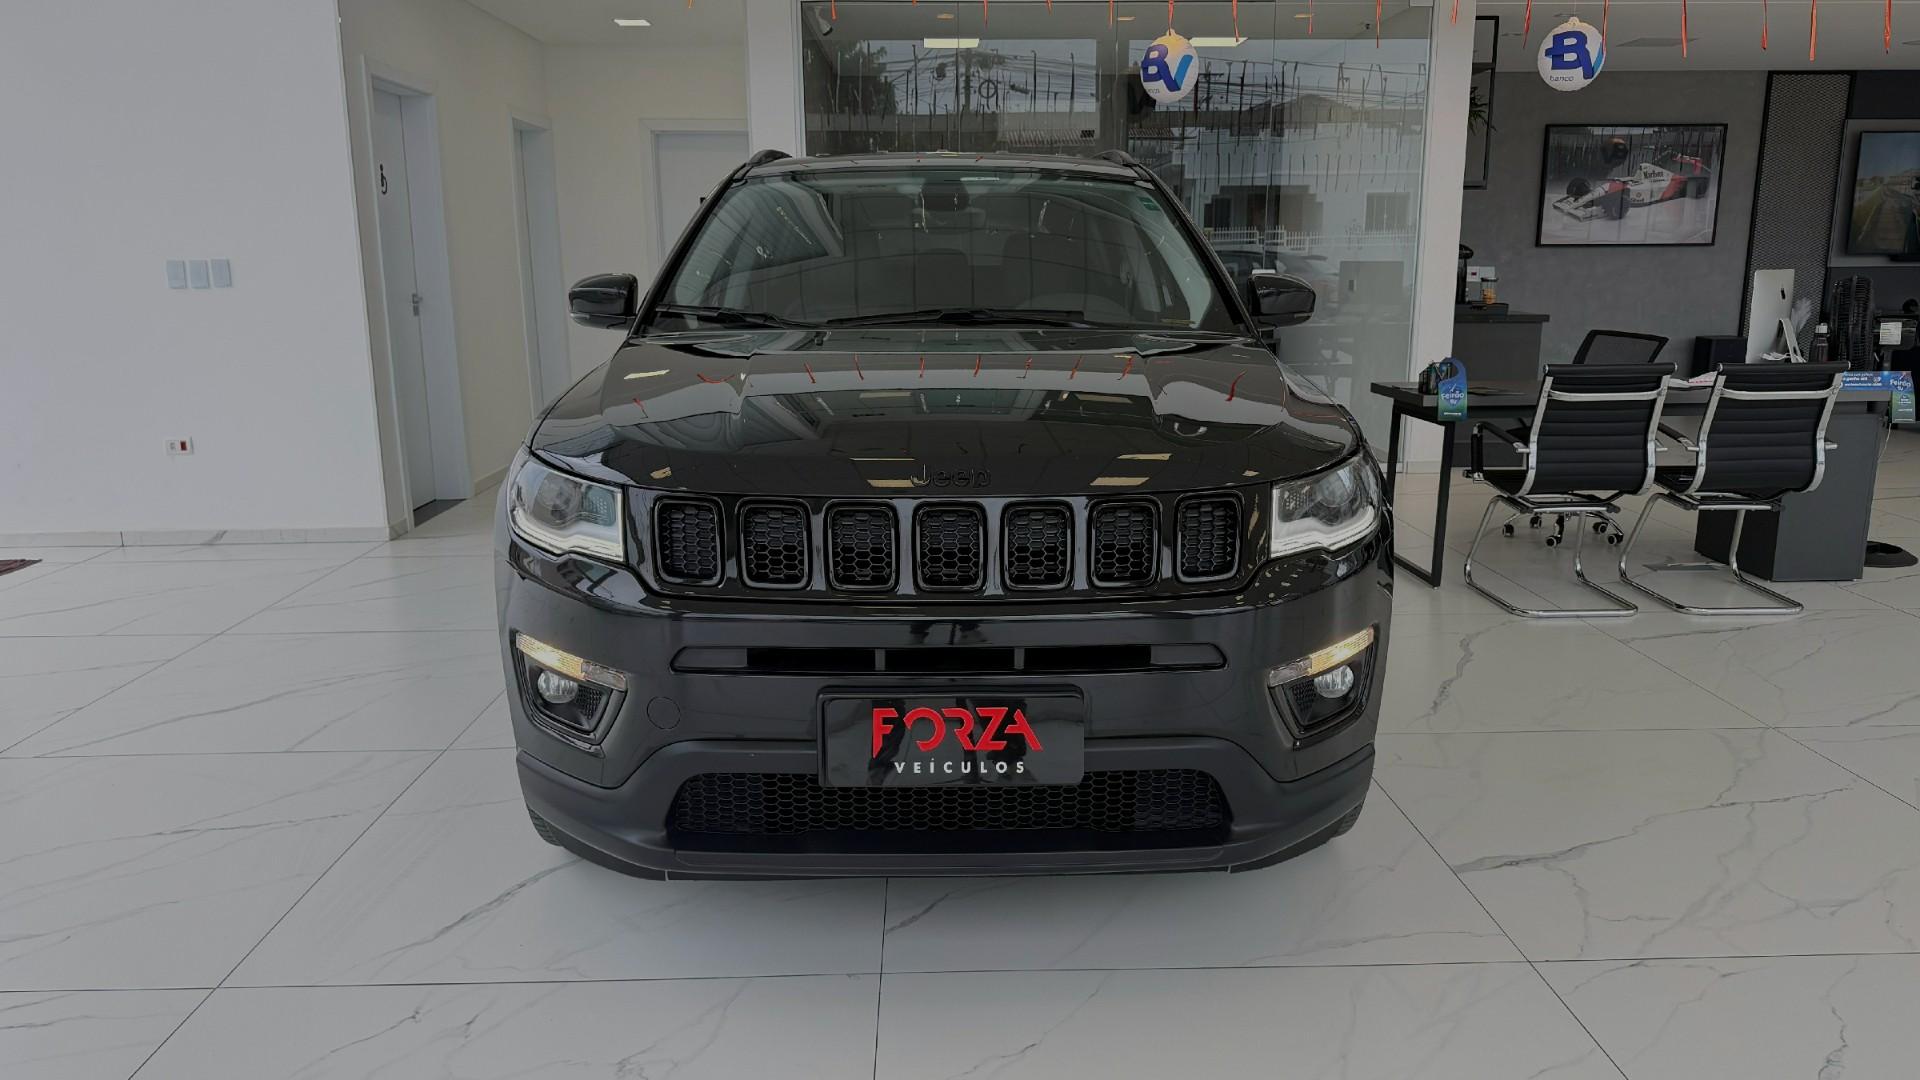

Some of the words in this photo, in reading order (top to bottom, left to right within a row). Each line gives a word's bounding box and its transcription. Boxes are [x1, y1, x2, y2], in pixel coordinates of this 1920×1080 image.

[1141, 43, 1194, 92] BV
[1544, 30, 1605, 80] BV
[911, 463, 992, 489] Jeep
[872, 707, 1044, 759] FORZA
[894, 758, 1026, 774] VEÍCULOS
